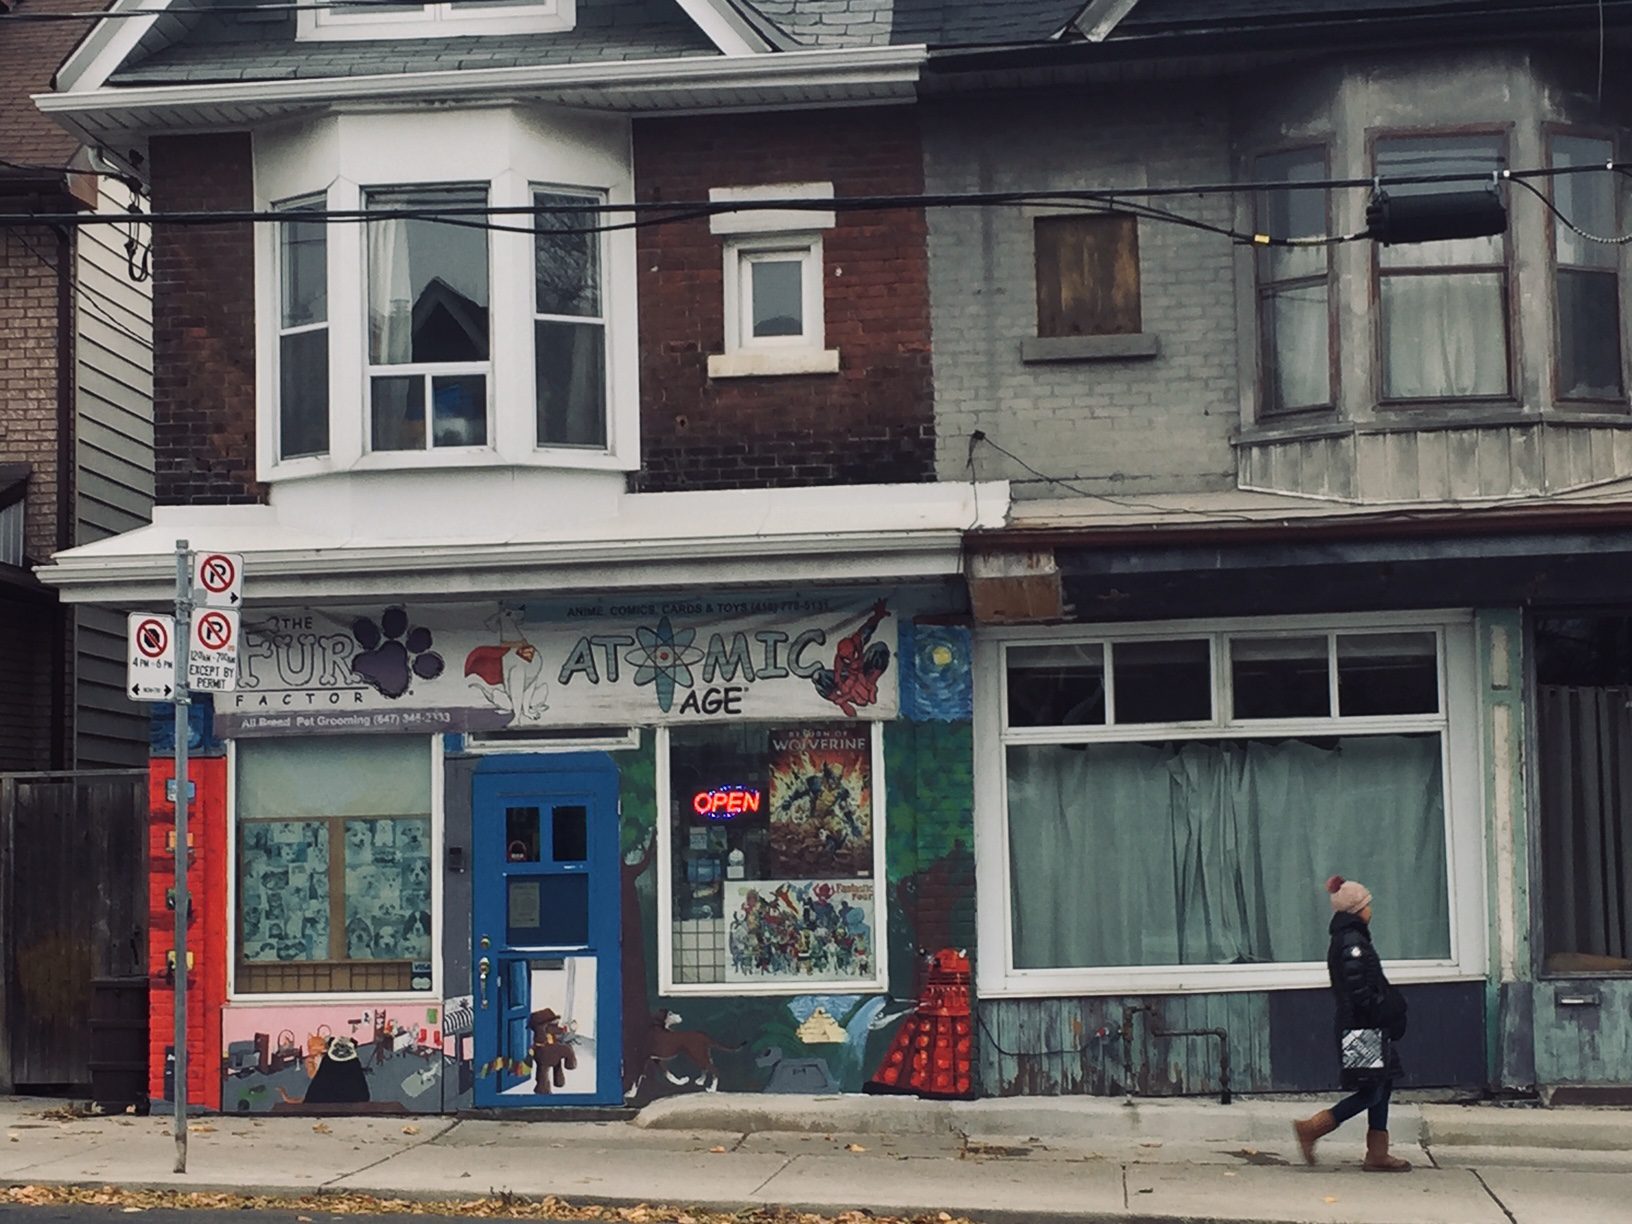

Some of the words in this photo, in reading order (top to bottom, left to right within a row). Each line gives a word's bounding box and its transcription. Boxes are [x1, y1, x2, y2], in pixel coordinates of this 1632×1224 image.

[662, 603, 703, 615] CARDS
[705, 603, 714, 613] &
[717, 602, 747, 613] TOYS
[281, 616, 313, 630] THE
[236, 616, 363, 688] FUR
[132, 657, 139, 667] 4
[140, 659, 149, 667] PM
[156, 659, 162, 669] 6
[164, 660, 173, 669] PM
[189, 664, 220, 676] EXCEPT
[223, 667, 235, 678] BY
[196, 677, 226, 689] PERMIT
[235, 692, 363, 707] FACTOR
[679, 687, 742, 715] AGE
[241, 717, 257, 728] All
[296, 716, 315, 727] Pet
[317, 714, 371, 728] Grooming
[772, 738, 866, 752] WOLVERINE
[693, 790, 761, 816] OPEN
